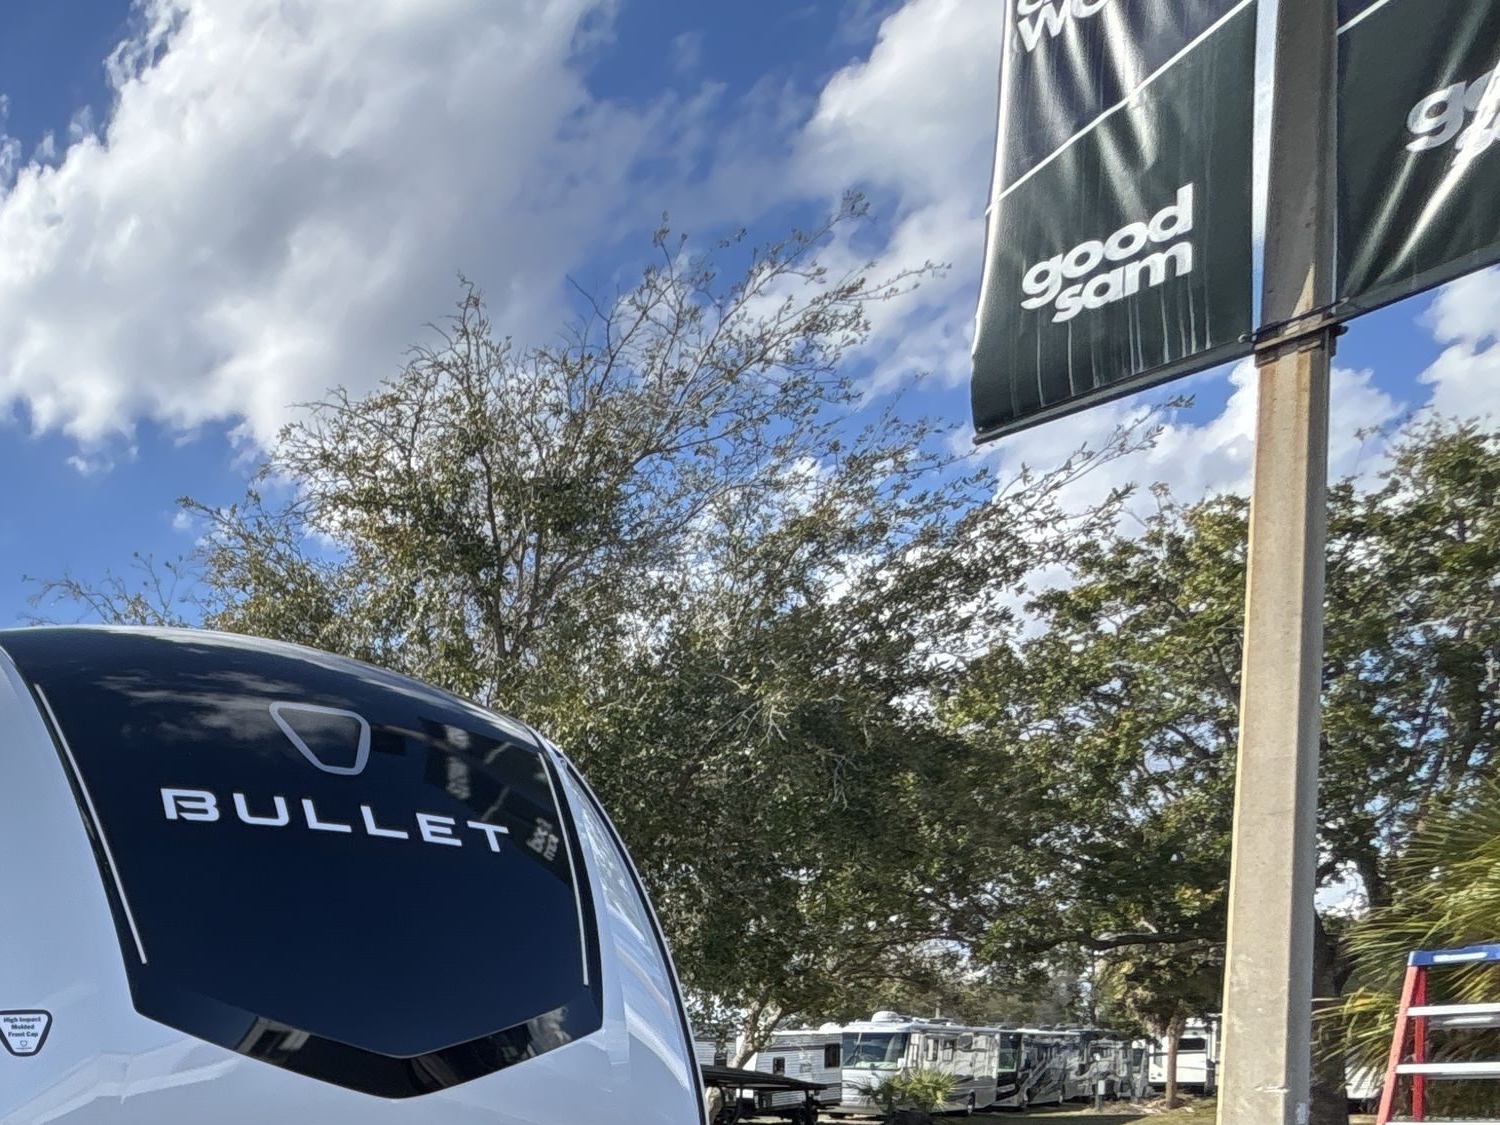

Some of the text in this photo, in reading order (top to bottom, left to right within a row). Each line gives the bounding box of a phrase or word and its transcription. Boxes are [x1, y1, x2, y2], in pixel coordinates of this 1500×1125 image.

[1021, 183, 1194, 311] good
[1051, 241, 1193, 324] sam
[160, 787, 510, 853] BULLET
